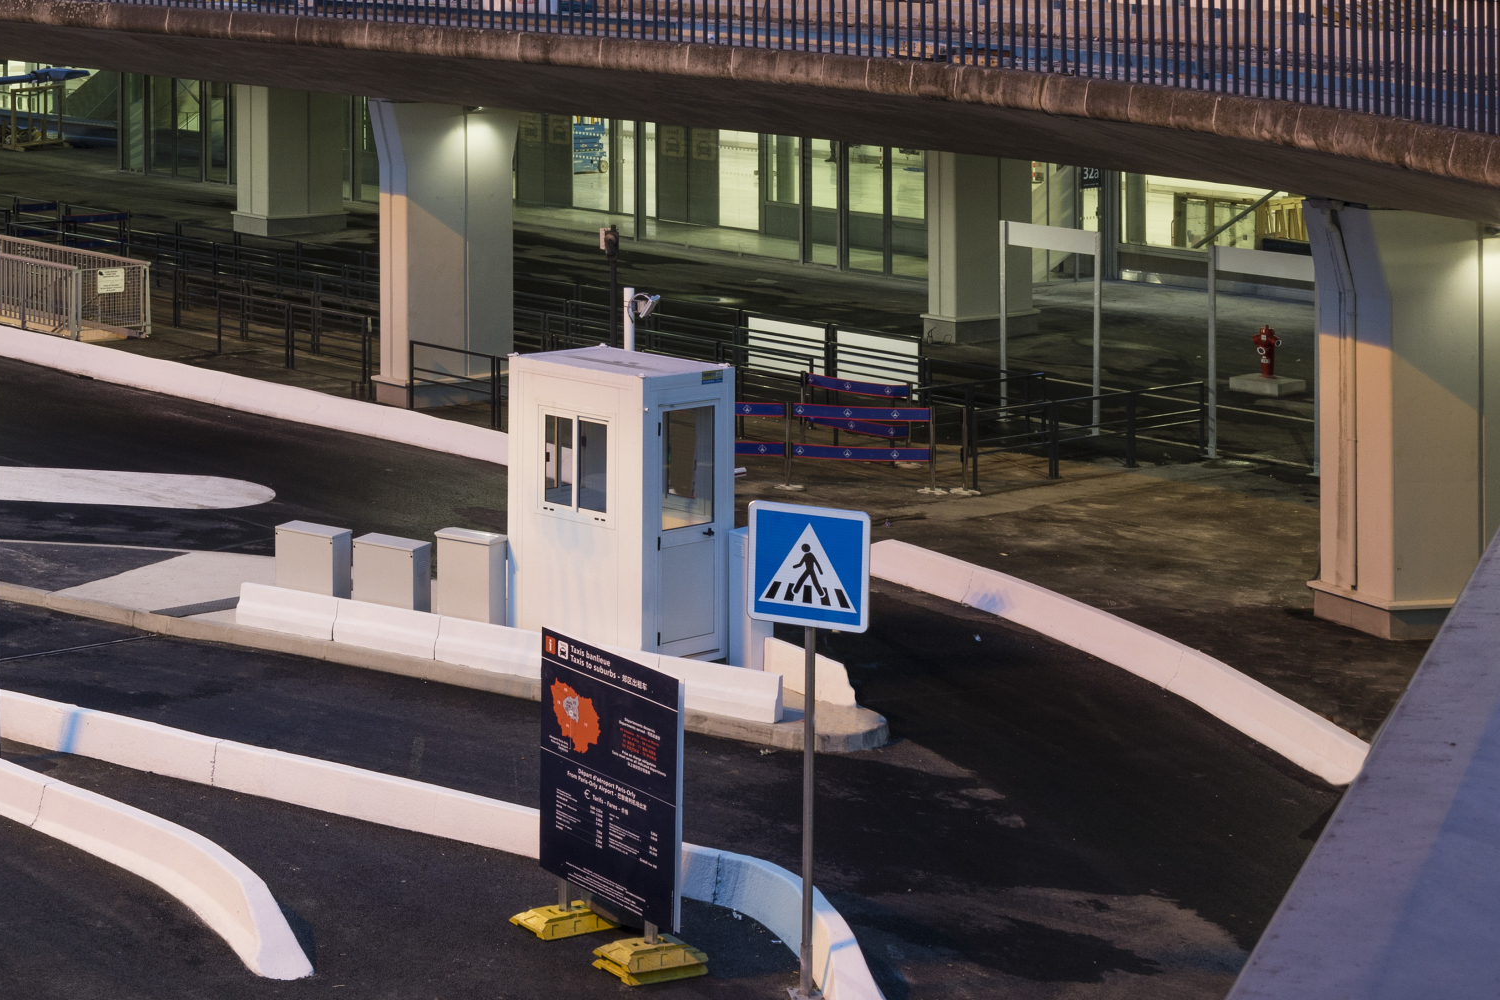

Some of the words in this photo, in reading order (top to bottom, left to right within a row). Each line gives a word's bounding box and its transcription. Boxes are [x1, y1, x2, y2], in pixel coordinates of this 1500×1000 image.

[1083, 166, 1099, 180] 32a
[570, 644, 584, 657] Taxis
[585, 650, 610, 667] banlieue
[570, 654, 584, 666] Taxis
[585, 661, 592, 669] to
[593, 663, 616, 679] suburbs
[567, 769, 577, 779] From
[578, 774, 597, 790] Paris-Orly
[598, 783, 613, 796] Airport
[577, 767, 592, 780] Départ
[615, 784, 635, 799] Paris-Orly
[592, 793, 603, 804] Tarifs
[606, 800, 617, 810] Fares
